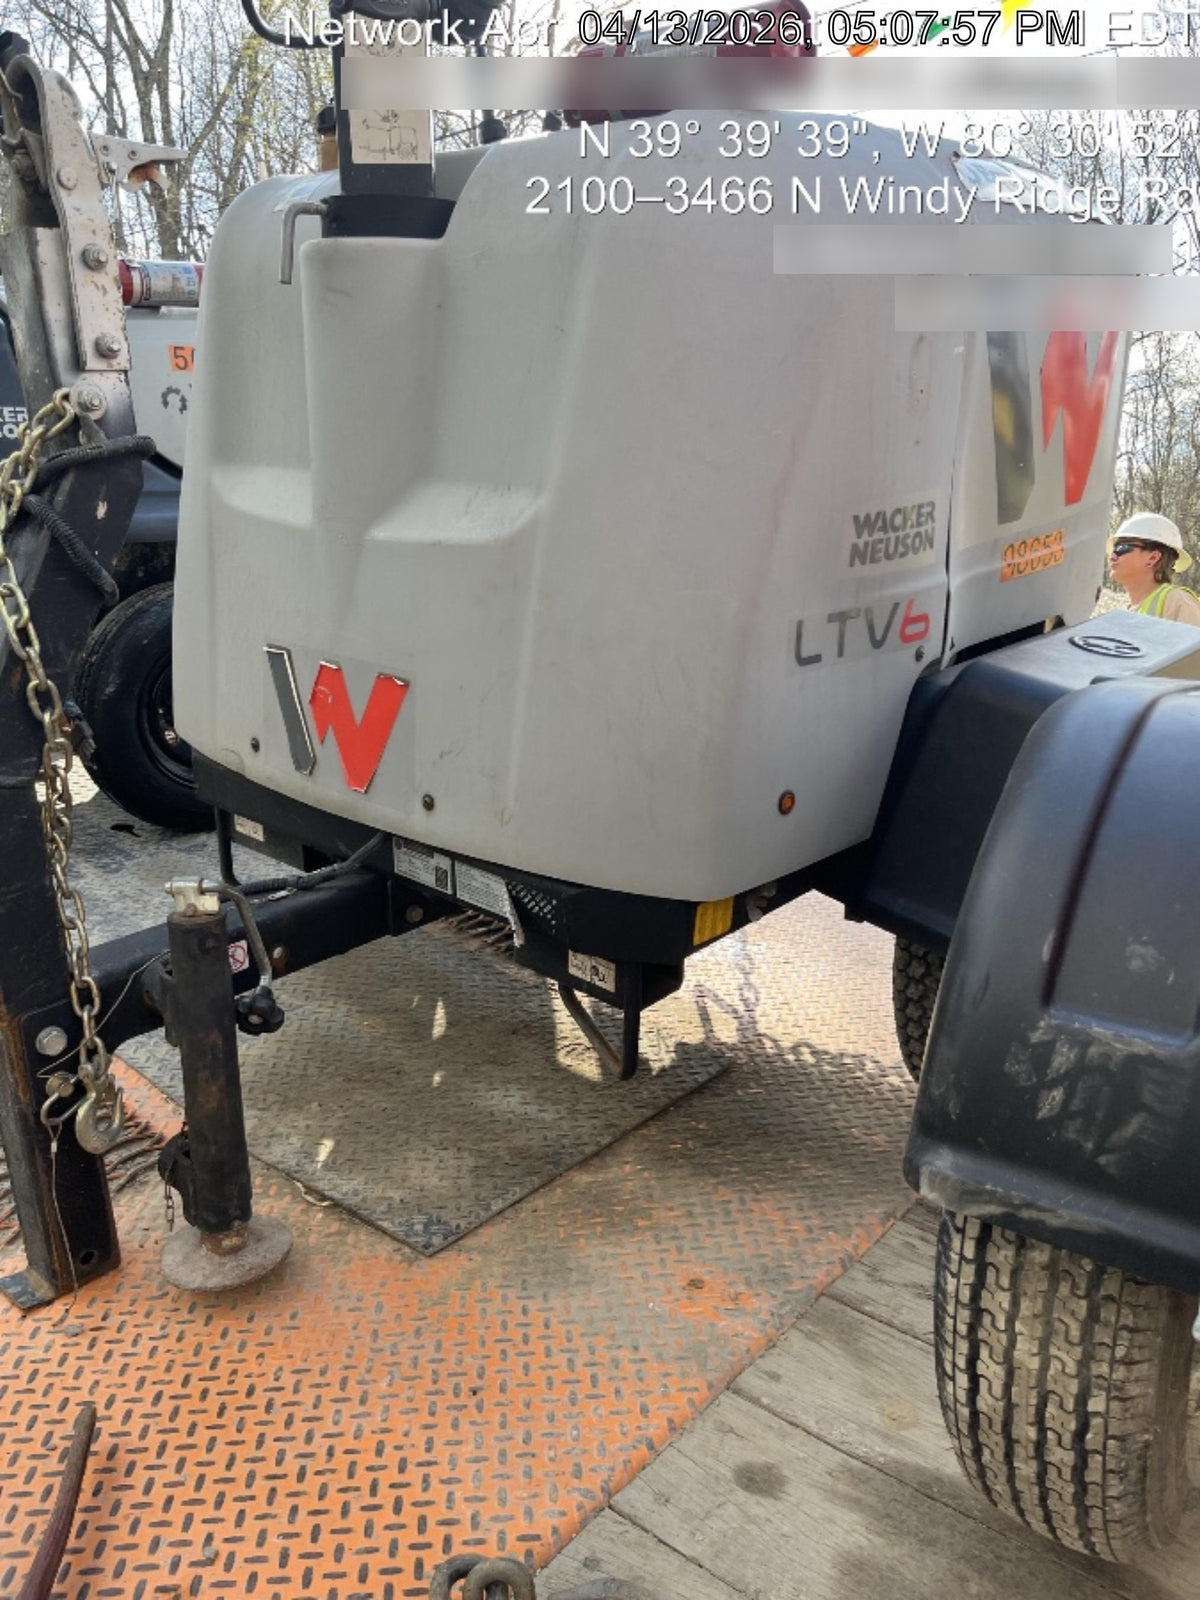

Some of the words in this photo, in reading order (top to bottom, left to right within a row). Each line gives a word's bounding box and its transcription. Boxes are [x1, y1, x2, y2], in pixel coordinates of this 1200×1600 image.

[852, 500, 936, 539] WACKER
[848, 525, 935, 568] NEUSON
[794, 597, 931, 667] LTV6
